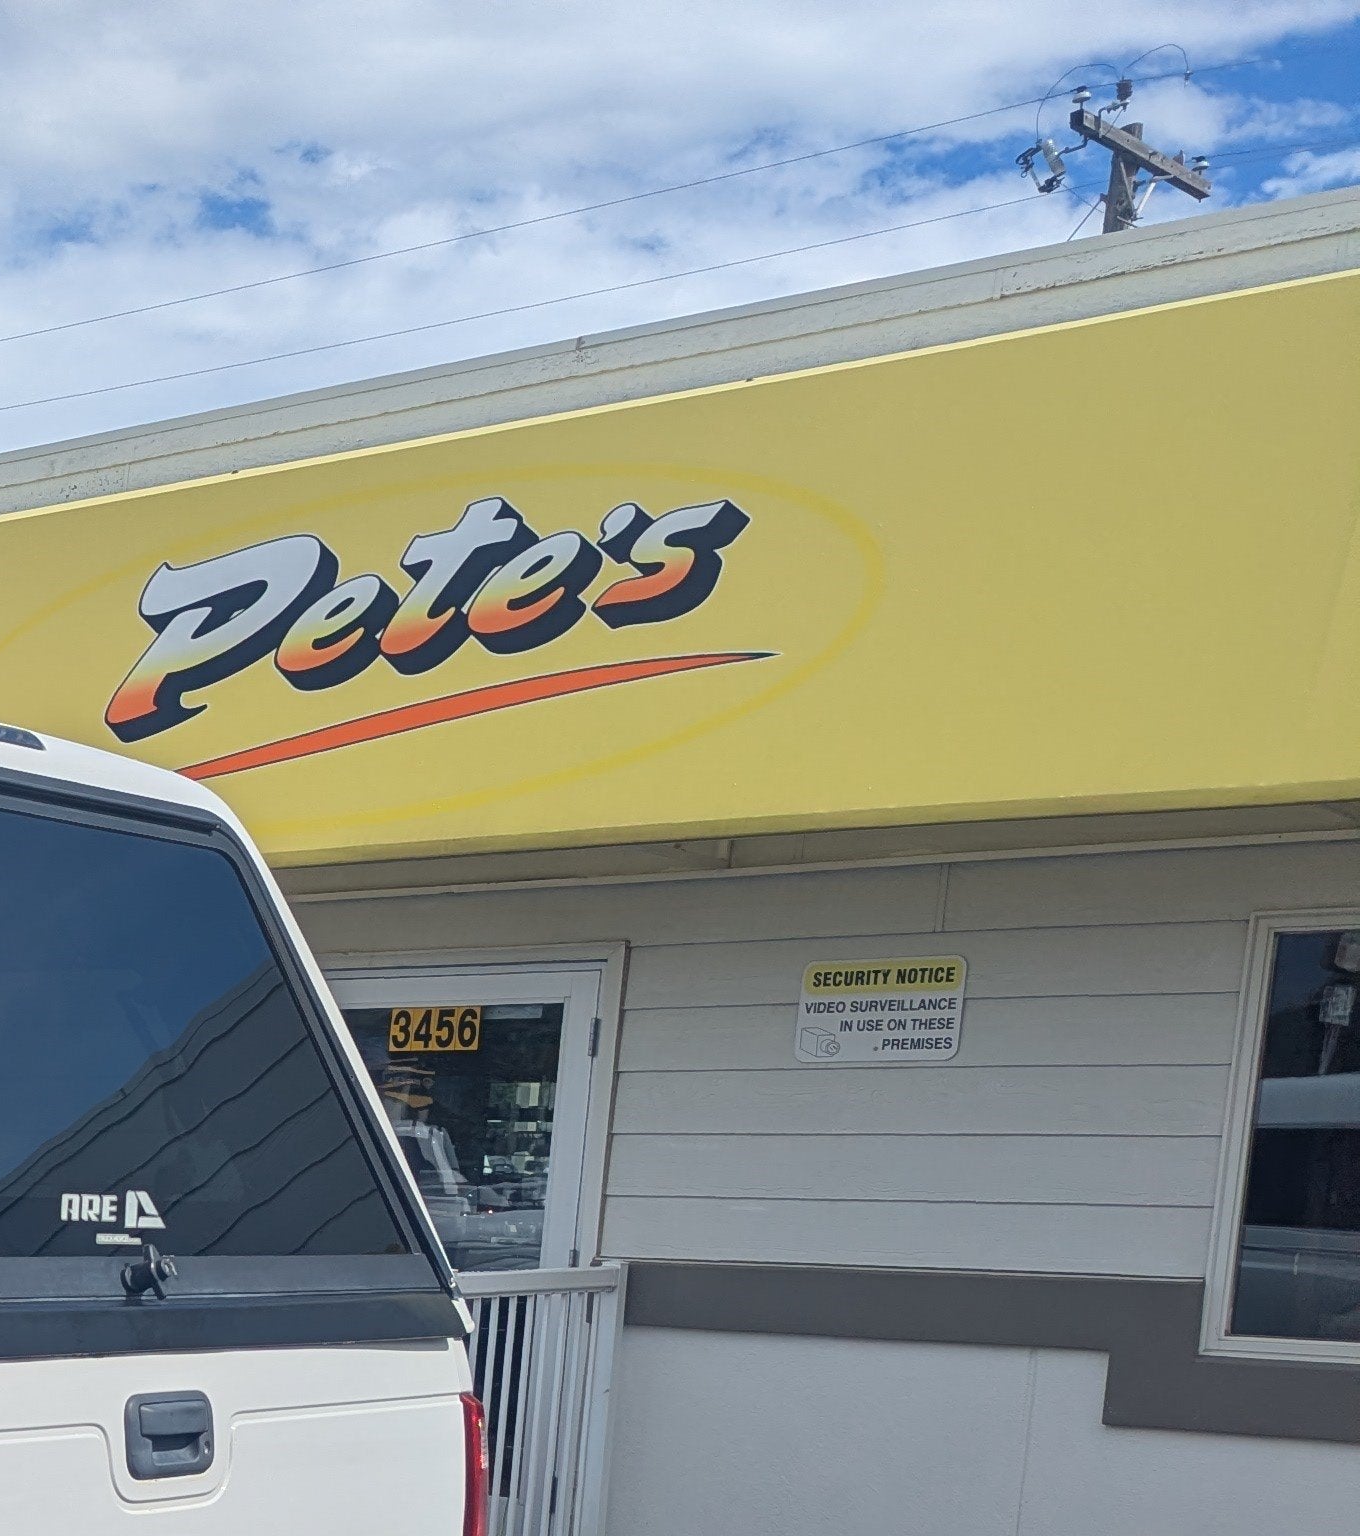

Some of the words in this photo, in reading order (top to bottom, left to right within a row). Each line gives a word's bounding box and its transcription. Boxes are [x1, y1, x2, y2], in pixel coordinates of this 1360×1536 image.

[105, 497, 751, 744] Pete's
[813, 969, 891, 988] SECURITY
[896, 967, 956, 984] NOTICE
[805, 1001, 846, 1014] VIDEO
[850, 998, 957, 1013] SURVEILLANCE
[392, 1009, 478, 1048] 3456
[840, 1020, 853, 1032] IN
[856, 1019, 883, 1032] USE
[887, 1018, 907, 1031] ON
[910, 1017, 955, 1030] THESE
[882, 1037, 953, 1050] PREMISES
[61, 1193, 118, 1222] ARE
